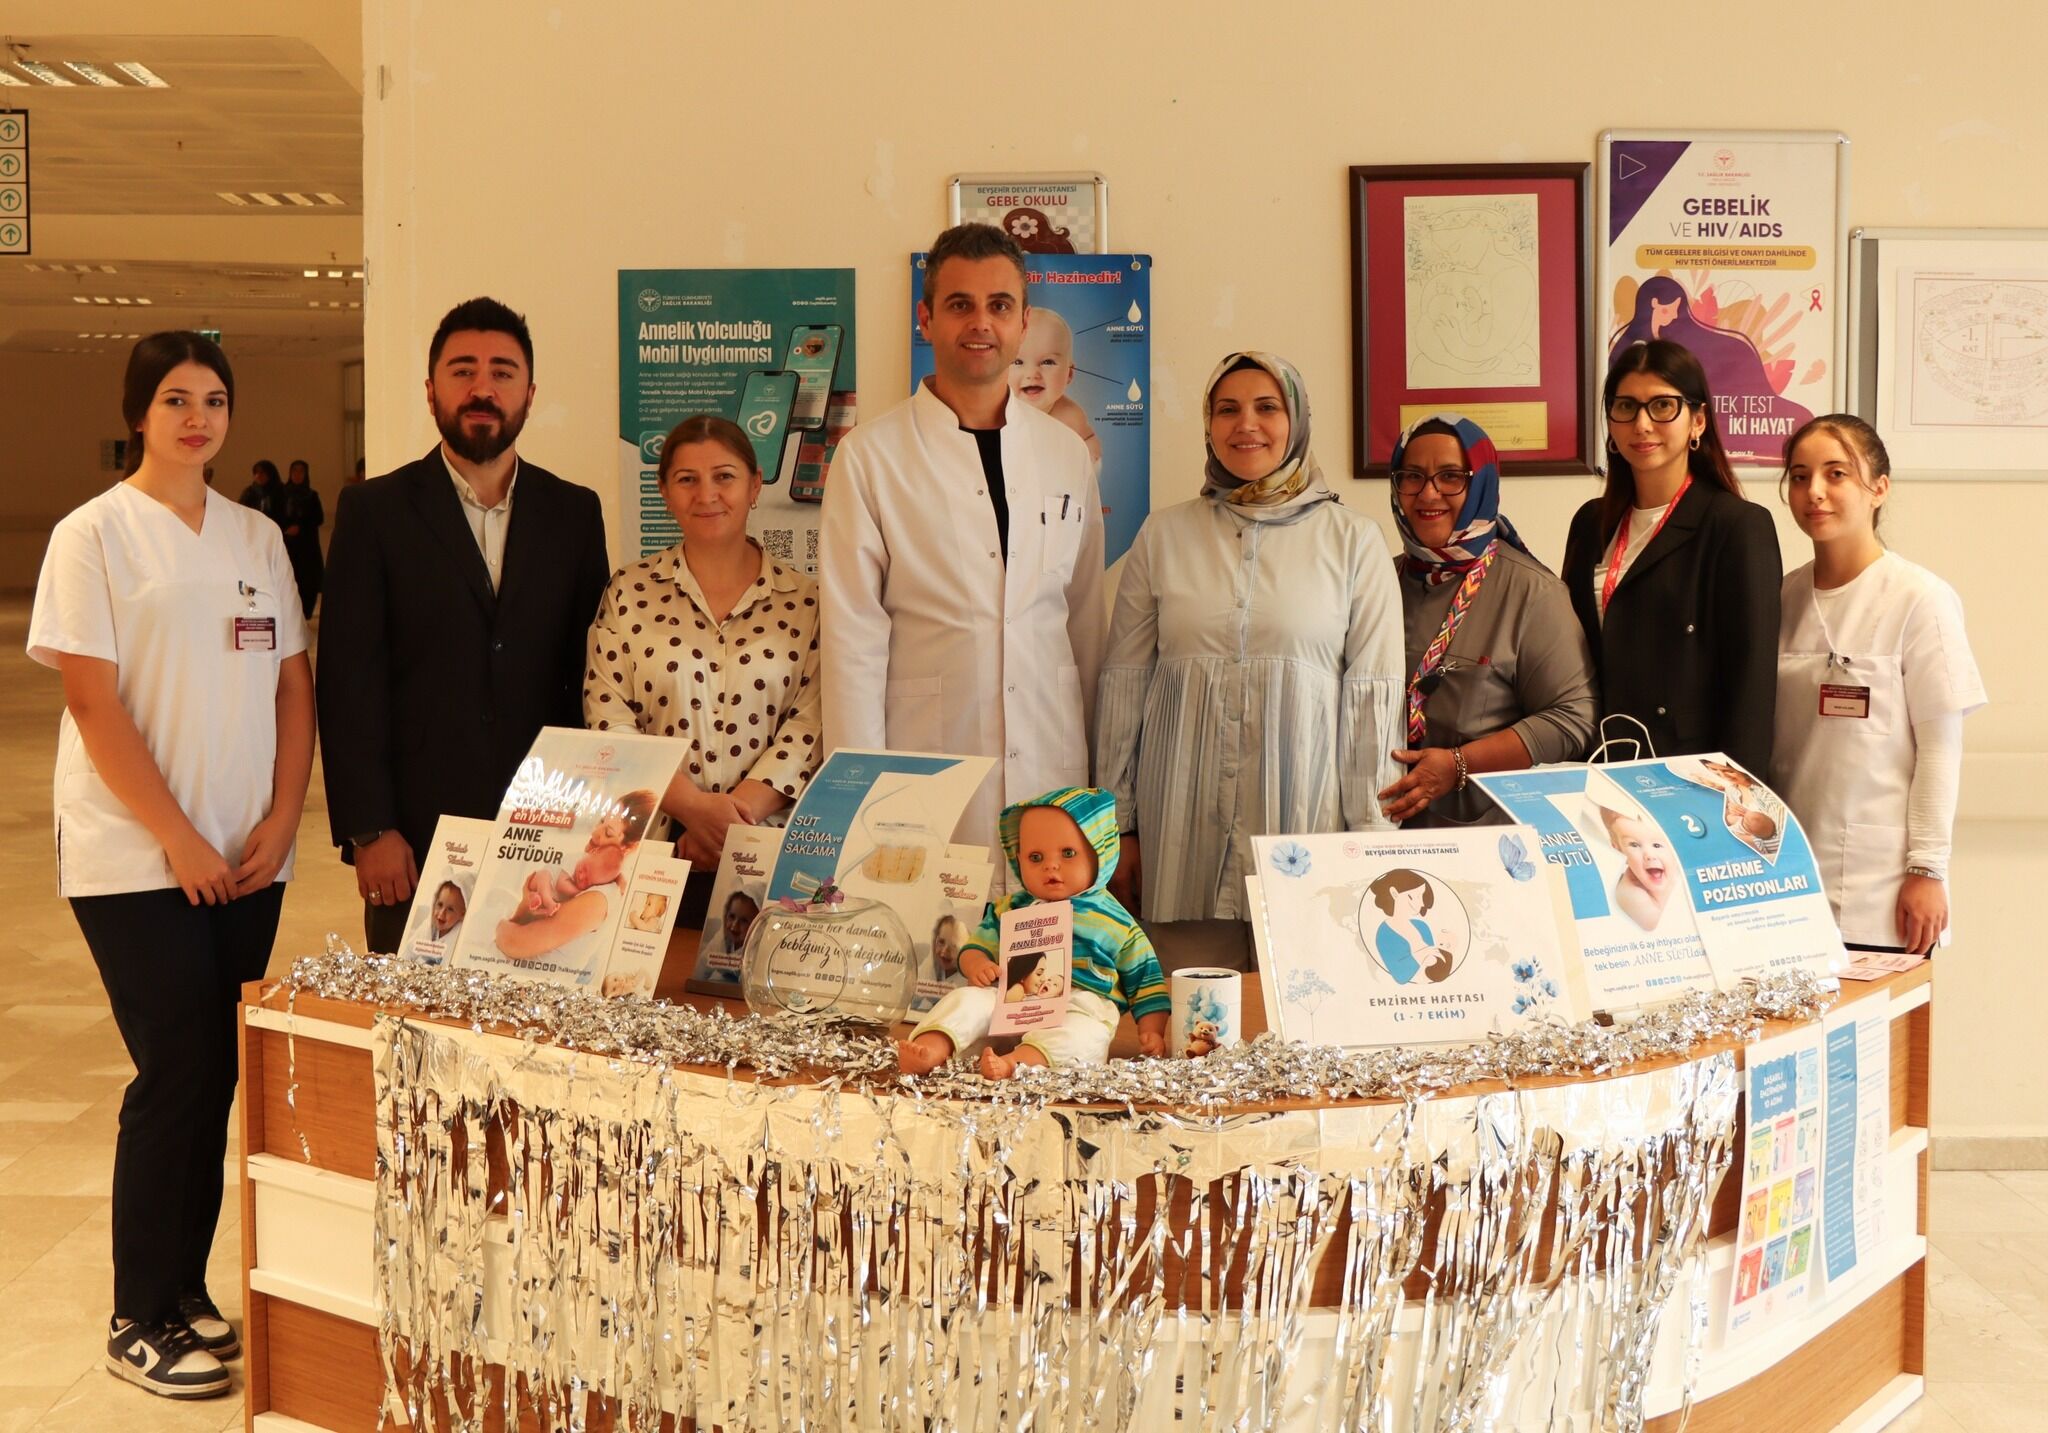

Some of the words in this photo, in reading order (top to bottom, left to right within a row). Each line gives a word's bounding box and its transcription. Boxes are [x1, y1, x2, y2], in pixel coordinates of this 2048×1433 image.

[977, 185, 1009, 194] BEYŞEHİR
[1011, 186, 1037, 194] DEVLET
[1039, 184, 1077, 193] HASTANESİ
[986, 196, 1019, 207] GEBE
[1023, 195, 1067, 206] OKULU
[1683, 194, 1770, 217] GEBELİK
[1670, 222, 1691, 238] VE
[1646, 248, 1663, 256] TÜM
[1664, 249, 1701, 257] GEBELERE
[1703, 249, 1728, 257] BİLGİSİ
[1730, 249, 1740, 257] VE
[1741, 249, 1765, 257] ONAYI
[1766, 249, 1807, 257] DAHİLİNDE
[1690, 258, 1711, 266] TESTİ
[1712, 258, 1776, 267] ÖNERİLMEKTEDİR
[1046, 270, 1122, 284] Hazinedir!
[639, 321, 695, 340] Annelik
[697, 319, 772, 342] Yolculuğu
[1126, 324, 1144, 332] SÜTÜ
[639, 344, 680, 364] Mobil
[682, 344, 772, 366] Uygulaması
[1711, 395, 1738, 414] TEK
[1742, 395, 1775, 414] TEST
[1728, 414, 1747, 435] İKİ
[1750, 417, 1795, 435] HAYAT
[514, 811, 527, 820] en
[543, 811, 572, 825] besin
[794, 814, 821, 827] SÜT
[1681, 815, 1700, 833] 2
[503, 826, 543, 843] ANNE
[789, 829, 832, 844] SAĞMA
[1539, 831, 1583, 848] ANNE
[497, 842, 563, 865] SÜTÜDÜR
[784, 843, 836, 857] SAKLAMA
[1365, 849, 1396, 857] BEYŞEHİR
[1548, 849, 1593, 868] SÜTÜ
[1696, 859, 1764, 884] EMZİRME
[1702, 875, 1809, 905] POZİSYONLARI
[846, 922, 887, 939] damlası
[1014, 915, 1059, 931] EMZİRME
[1030, 928, 1044, 938] VE
[1009, 939, 1037, 951] ANNE
[1038, 933, 1064, 947] SÜTÜ
[1584, 945, 1629, 958] Bebeğinizin
[1629, 943, 1638, 951] ilk
[1639, 940, 1646, 949] 6
[1646, 941, 1656, 951] ay
[1656, 937, 1684, 948] ihtiyacı
[1686, 934, 1701, 943] olan
[779, 938, 831, 969] bebeğiniz
[1594, 962, 1608, 972] tek
[1609, 959, 1630, 970] besin
[1632, 951, 1665, 967] ANNE
[1369, 994, 1427, 1007] EMZİRME
[1431, 993, 1485, 1004] HAFTASI
[1393, 1012, 1405, 1022] (1
[1418, 1012, 1423, 1020] 7
[1428, 1008, 1466, 1020] EKİM)
